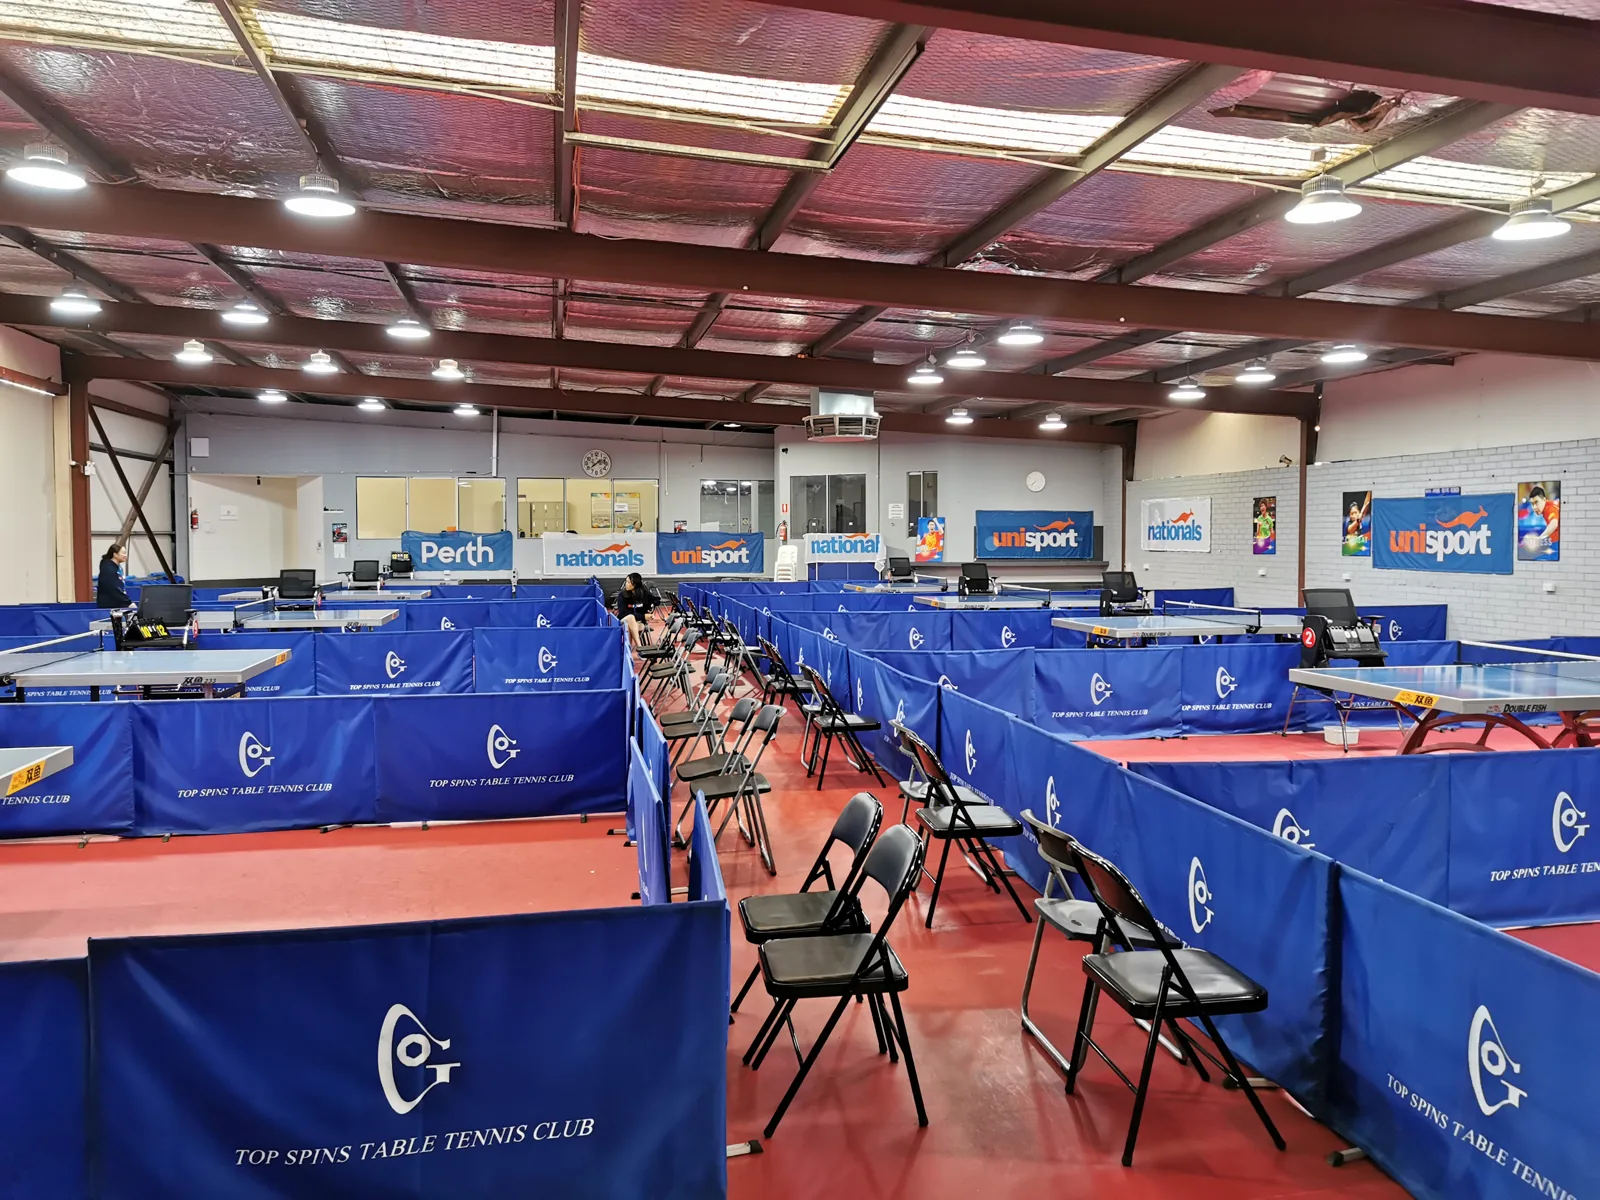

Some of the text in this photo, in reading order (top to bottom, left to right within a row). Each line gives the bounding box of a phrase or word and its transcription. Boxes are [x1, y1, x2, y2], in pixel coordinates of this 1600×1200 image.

[993, 528, 1078, 551] unisport
[1148, 520, 1202, 541] nationals
[421, 536, 494, 566] Perth
[811, 535, 880, 554] national
[1390, 524, 1491, 561] unisport
[556, 550, 644, 567] nationals
[672, 546, 749, 567] unisport
[1306, 631, 1312, 644] 2
[1503, 704, 1531, 712] DOUBLE
[450, 779, 477, 787] SPINS
[480, 778, 511, 786] TABLE
[513, 776, 546, 785] TENNIS
[548, 774, 574, 782] CLUB
[2, 795, 70, 805] TENNIS CLUB
[178, 783, 332, 798] TOP SPINS TABLE TENNIS CLUB
[1490, 862, 1600, 881] TOP SPINS TABLE TEN
[1387, 1072, 1408, 1099] TOP
[1410, 1093, 1449, 1129] SPINS
[1452, 1121, 1509, 1166] TABLE
[235, 1117, 595, 1166] TOP SPINS TABLE TENNIS CLUB
